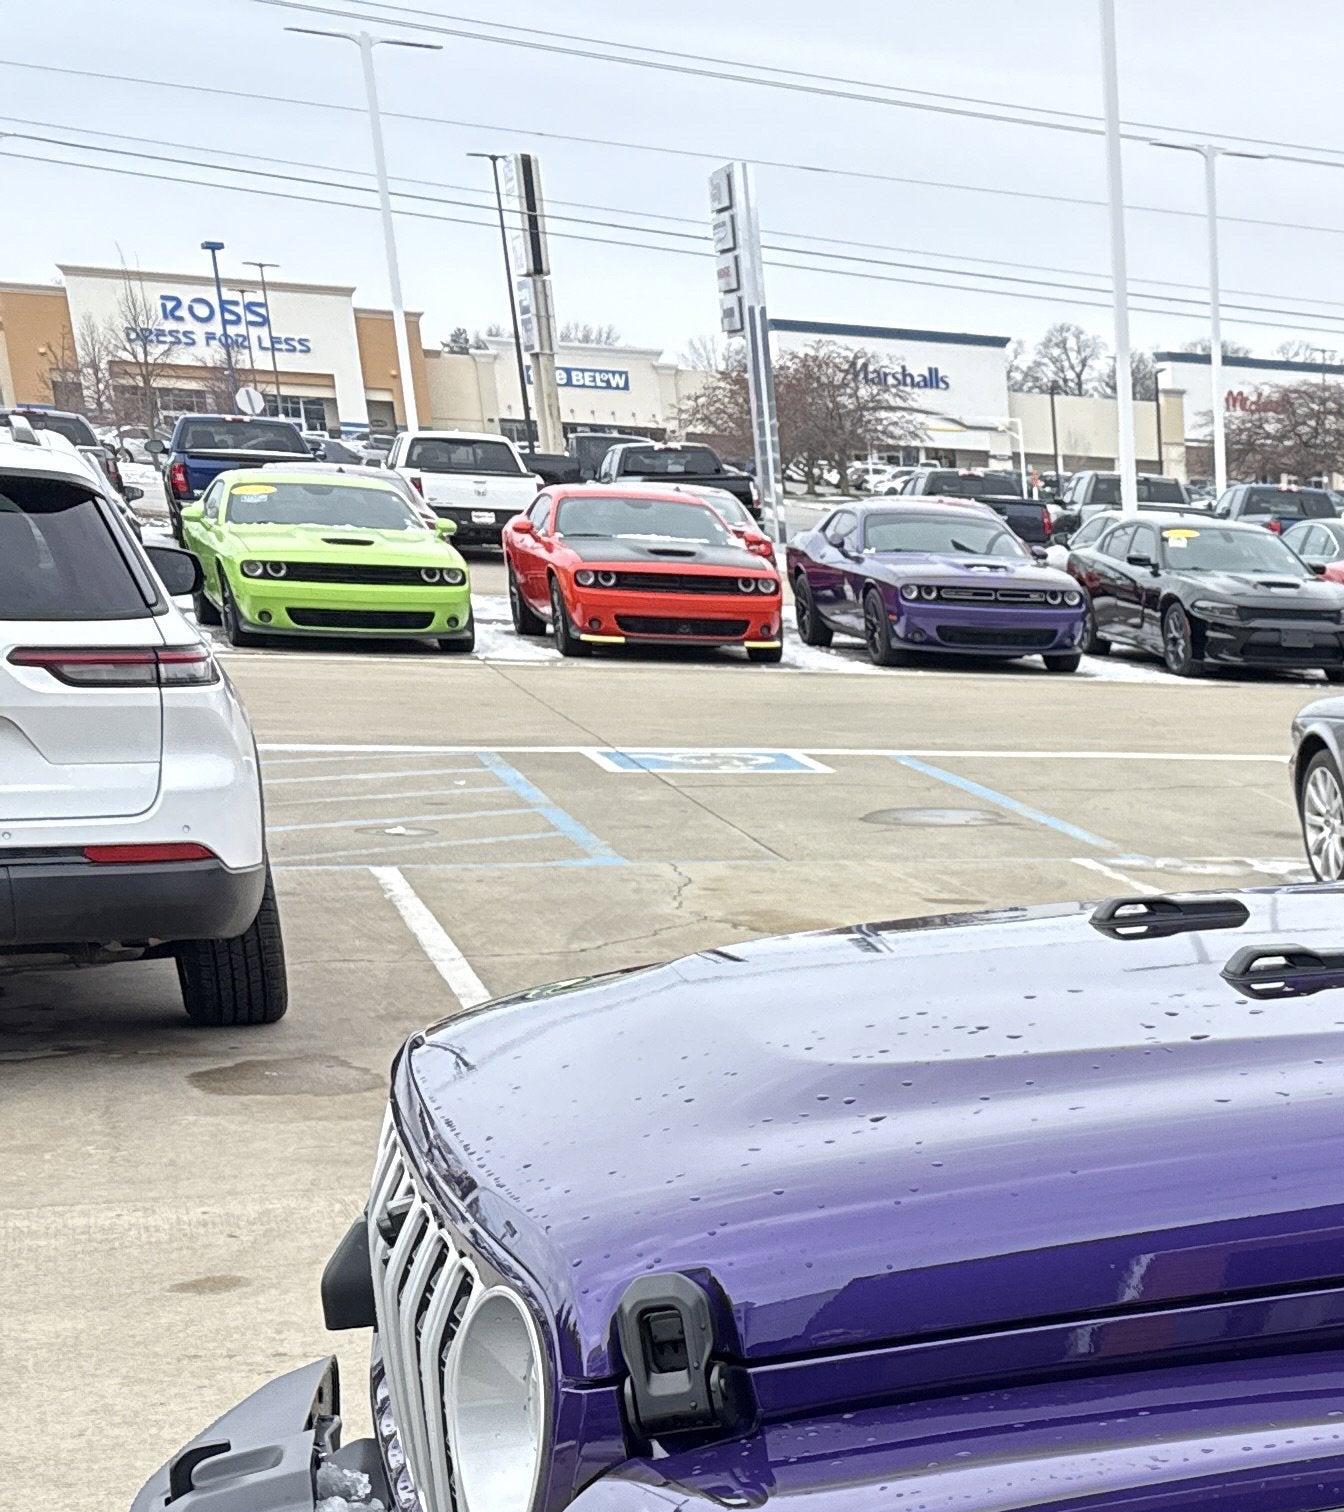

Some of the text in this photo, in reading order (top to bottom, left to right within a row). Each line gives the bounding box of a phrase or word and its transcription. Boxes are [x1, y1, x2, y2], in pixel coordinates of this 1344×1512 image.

[159, 294, 270, 327] ROSS
[204, 331, 250, 350] FOR
[257, 335, 312, 353] LESS
